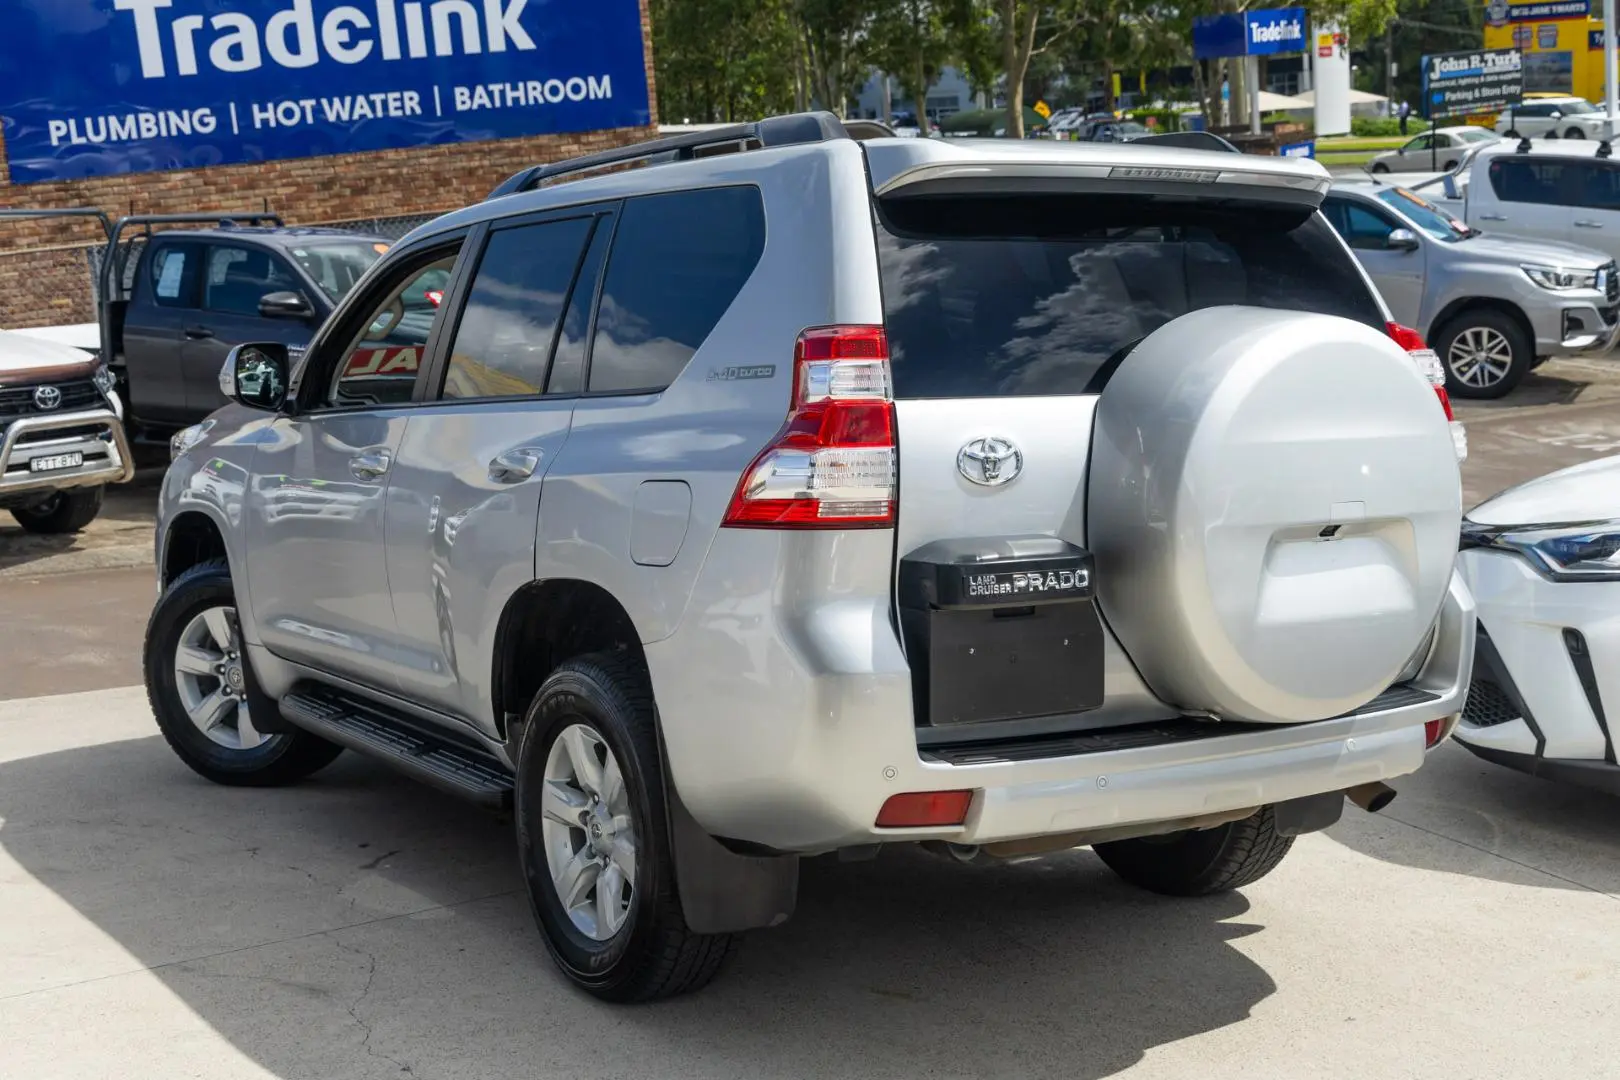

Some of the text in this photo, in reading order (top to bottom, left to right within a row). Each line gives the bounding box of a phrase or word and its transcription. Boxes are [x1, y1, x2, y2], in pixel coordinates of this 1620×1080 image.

[113, 0, 536, 78] Tradelink
[1250, 19, 1301, 43] Tradelink
[1429, 57, 1469, 80] John
[1444, 90, 1473, 101] Parking
[1502, 84, 1521, 95] Entry
[48, 75, 612, 146] PLUMBING HOT WATER BATHROOM
[969, 574, 997, 586] LAND
[969, 583, 1012, 596] CRUISER
[1012, 569, 1089, 592] PRADO
